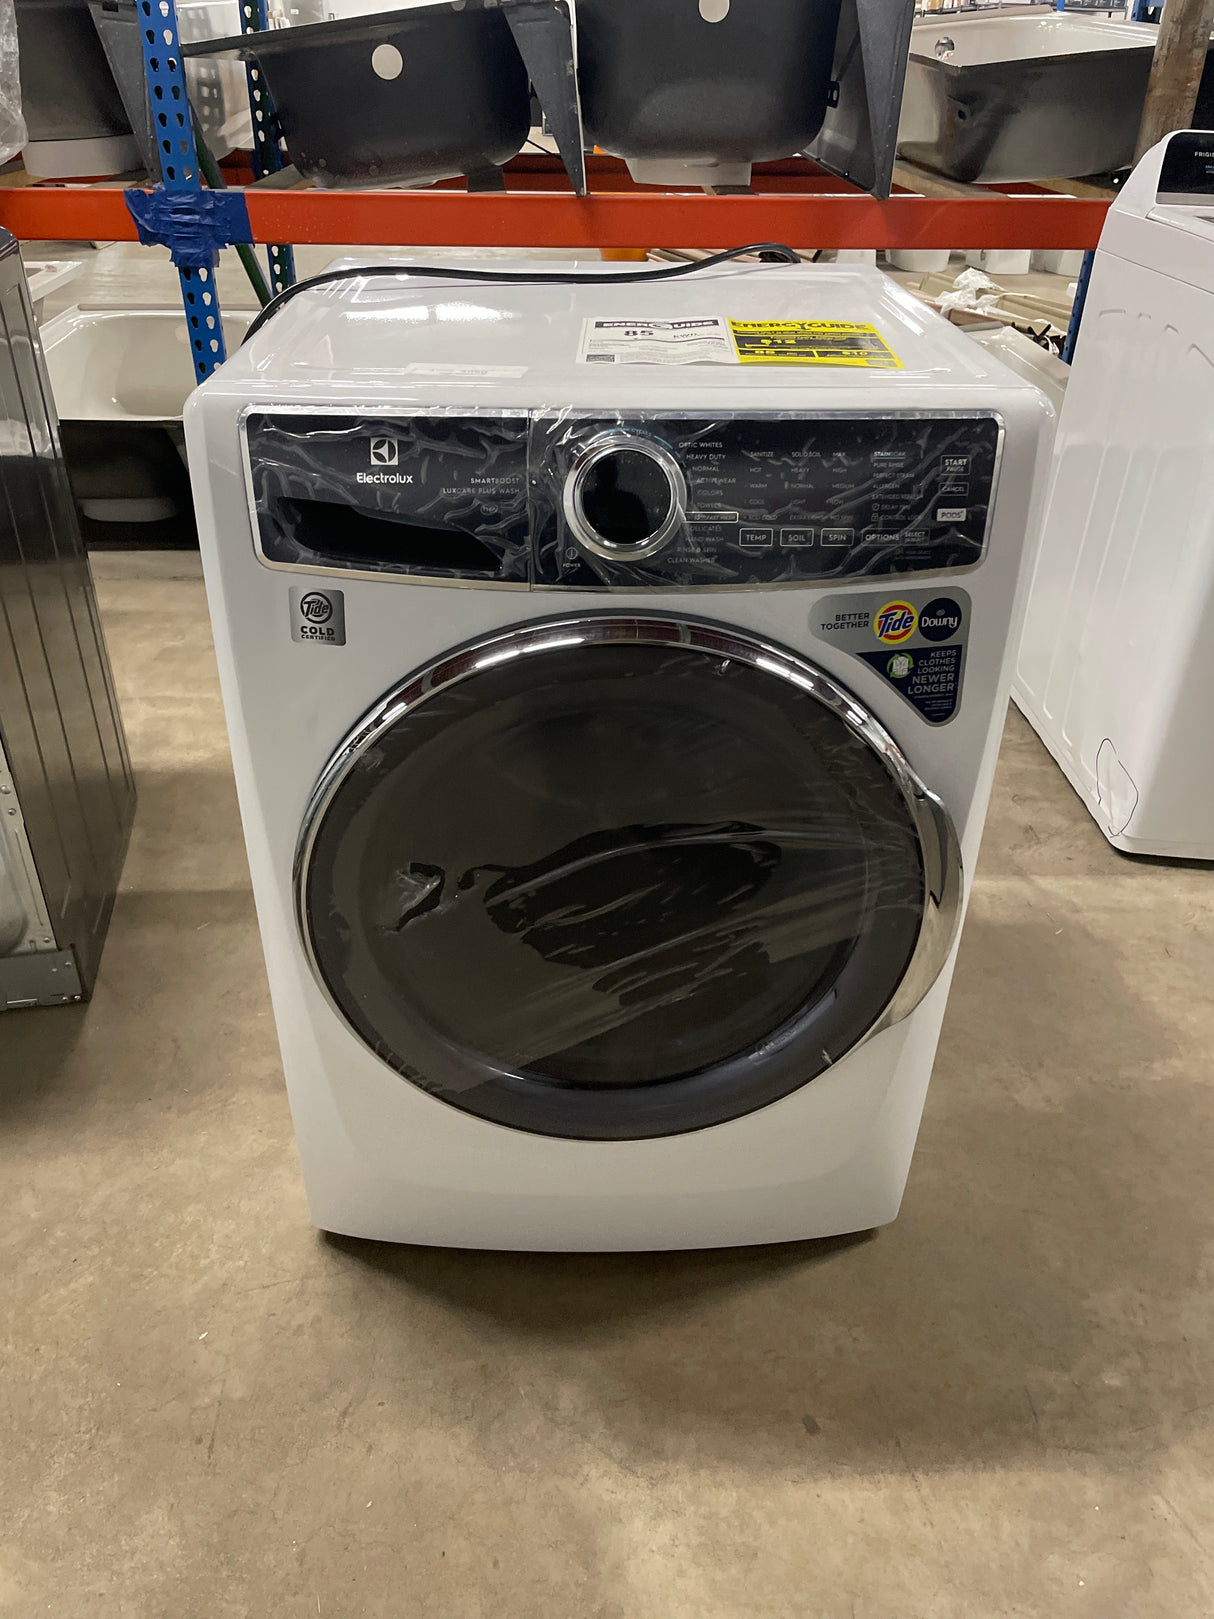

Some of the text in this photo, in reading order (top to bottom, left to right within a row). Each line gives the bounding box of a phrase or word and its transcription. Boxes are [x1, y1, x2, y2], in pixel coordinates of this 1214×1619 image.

[944, 458, 967, 466] START
[356, 472, 414, 484] Electrolux
[303, 599, 329, 617] Tide
[835, 612, 870, 621] BETTER
[820, 620, 869, 631] TOGETHER
[877, 609, 914, 640] Tide
[921, 616, 958, 629] Downy
[300, 625, 334, 636] COLD
[930, 649, 957, 657] KEEPS
[918, 657, 956, 667] CLOTHES
[917, 665, 955, 674] LOOKING
[912, 673, 954, 684] NEWER
